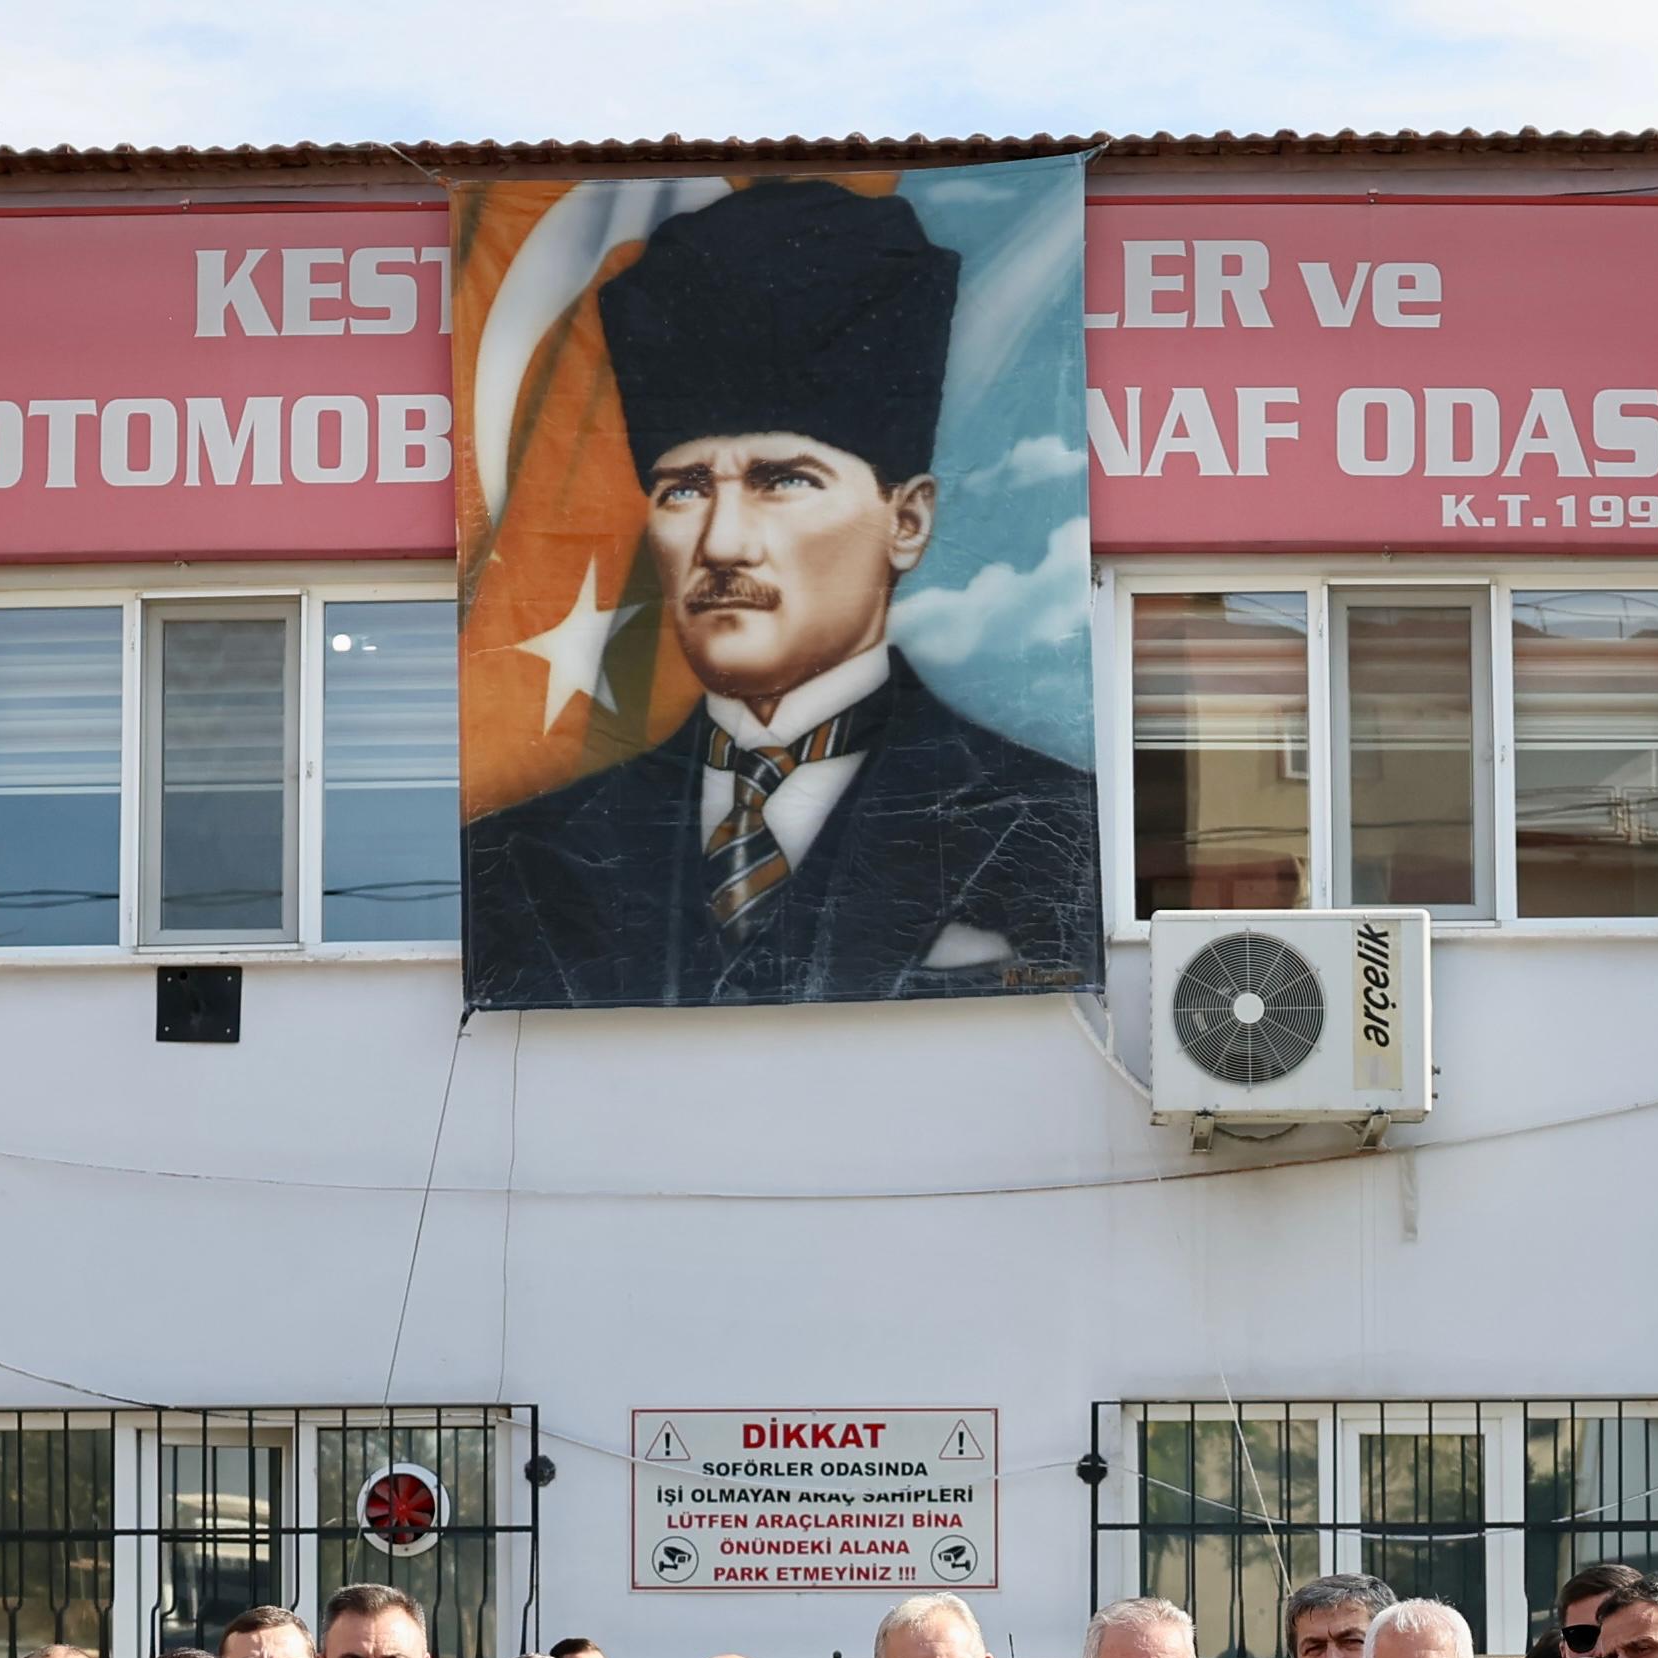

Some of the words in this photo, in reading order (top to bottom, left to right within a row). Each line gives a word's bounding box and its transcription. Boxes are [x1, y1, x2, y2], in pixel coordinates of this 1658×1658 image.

[1084, 239, 1274, 329] ER
[1298, 261, 1442, 329] ve
[1086, 386, 1300, 476] NAF
[1357, 923, 1396, 1048] arçelik
[742, 1417, 886, 1449] DİKKAT
[821, 1461, 928, 1477] ODASINDA
[657, 1485, 683, 1507] İŞİ
[691, 1488, 791, 1504] OLMAYAN
[667, 1511, 748, 1529] LÜTFEN
[755, 1513, 904, 1533] ARAÇLARINIZI
[912, 1510, 963, 1529] BİNA
[720, 1537, 831, 1555] ÖNÜNDEKİ
[839, 1540, 910, 1555] ALANA
[714, 1566, 769, 1582] PARK
[776, 1563, 891, 1581] ETMEYİNİZ
[898, 1566, 916, 1581] !!!
